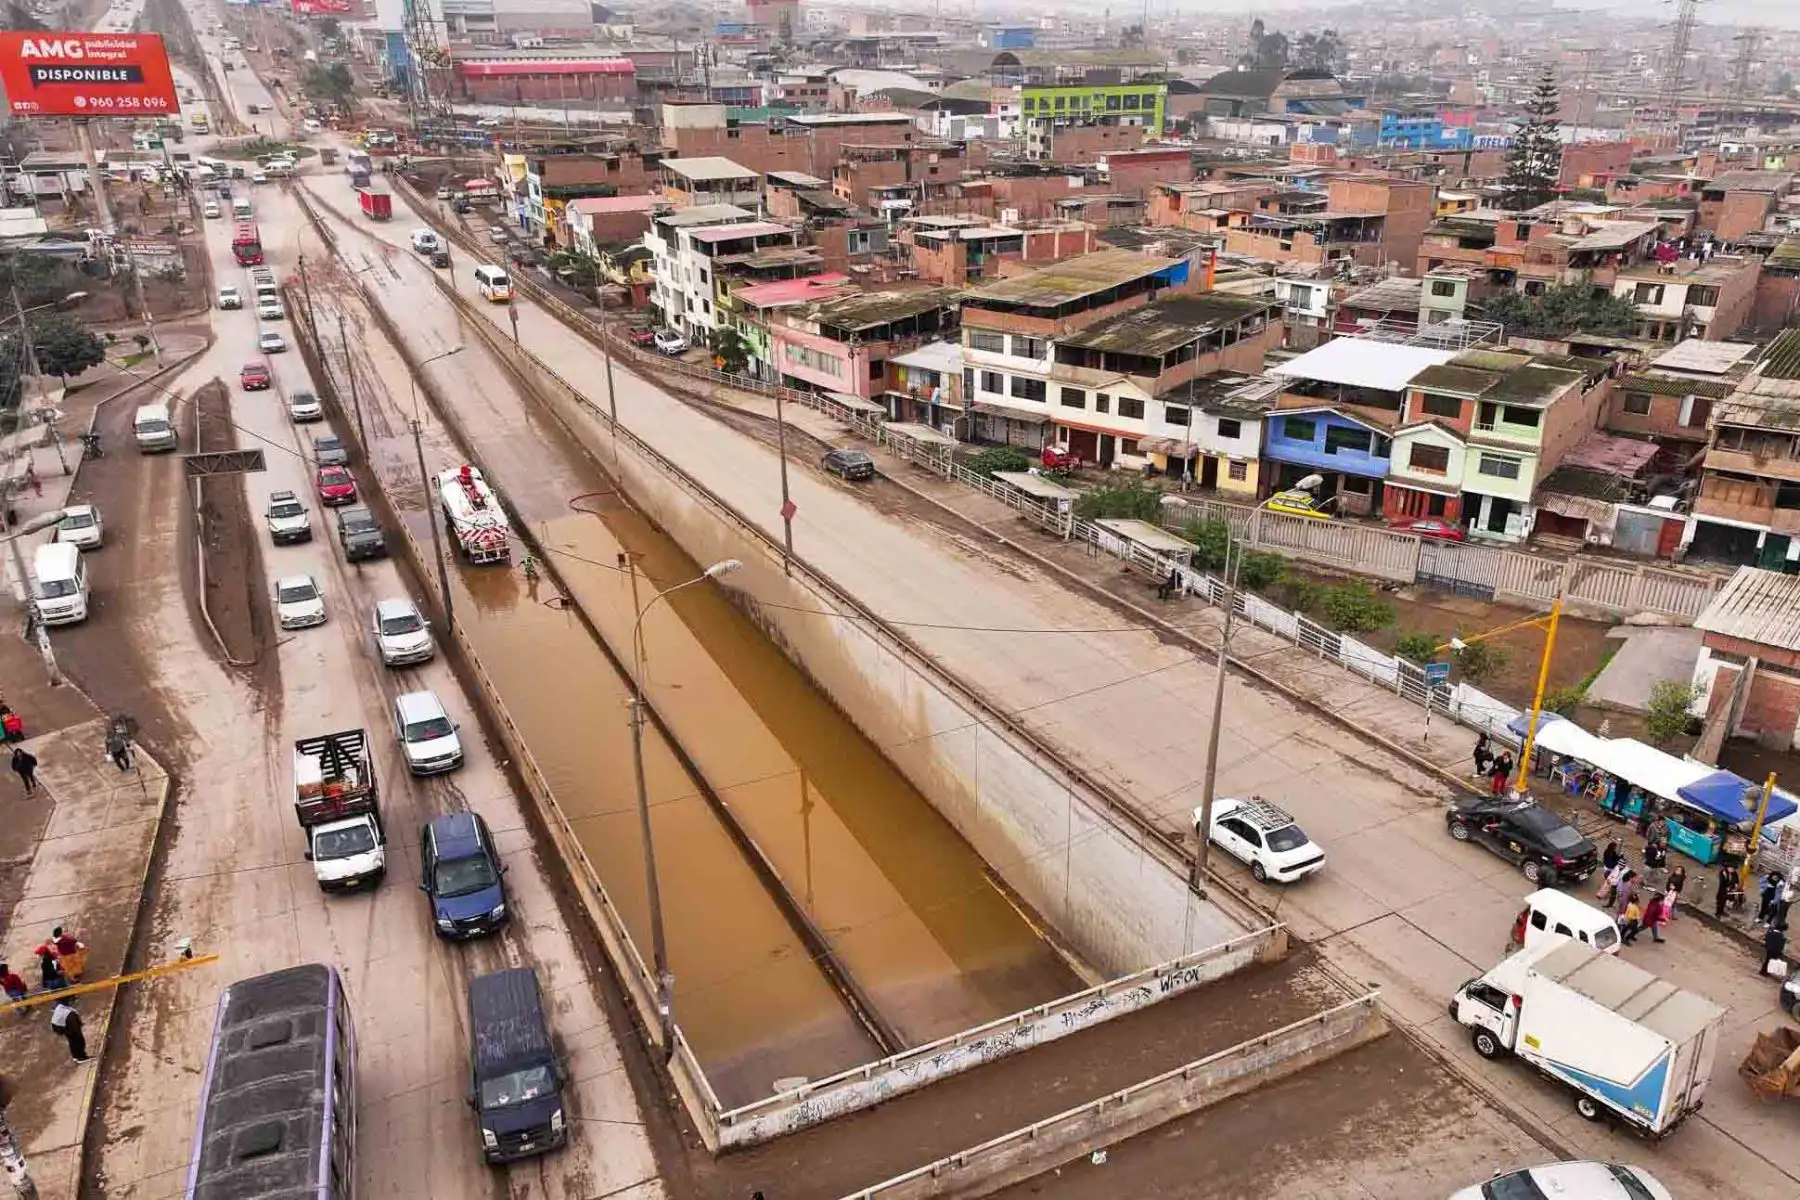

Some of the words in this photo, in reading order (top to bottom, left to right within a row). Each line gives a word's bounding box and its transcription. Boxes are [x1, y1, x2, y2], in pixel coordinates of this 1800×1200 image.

[21, 39, 83, 58] AMG
[37, 69, 127, 81] DISPONIBLE
[90, 97, 113, 108] 960
[117, 97, 140, 108] 258
[144, 96, 167, 108] 096
